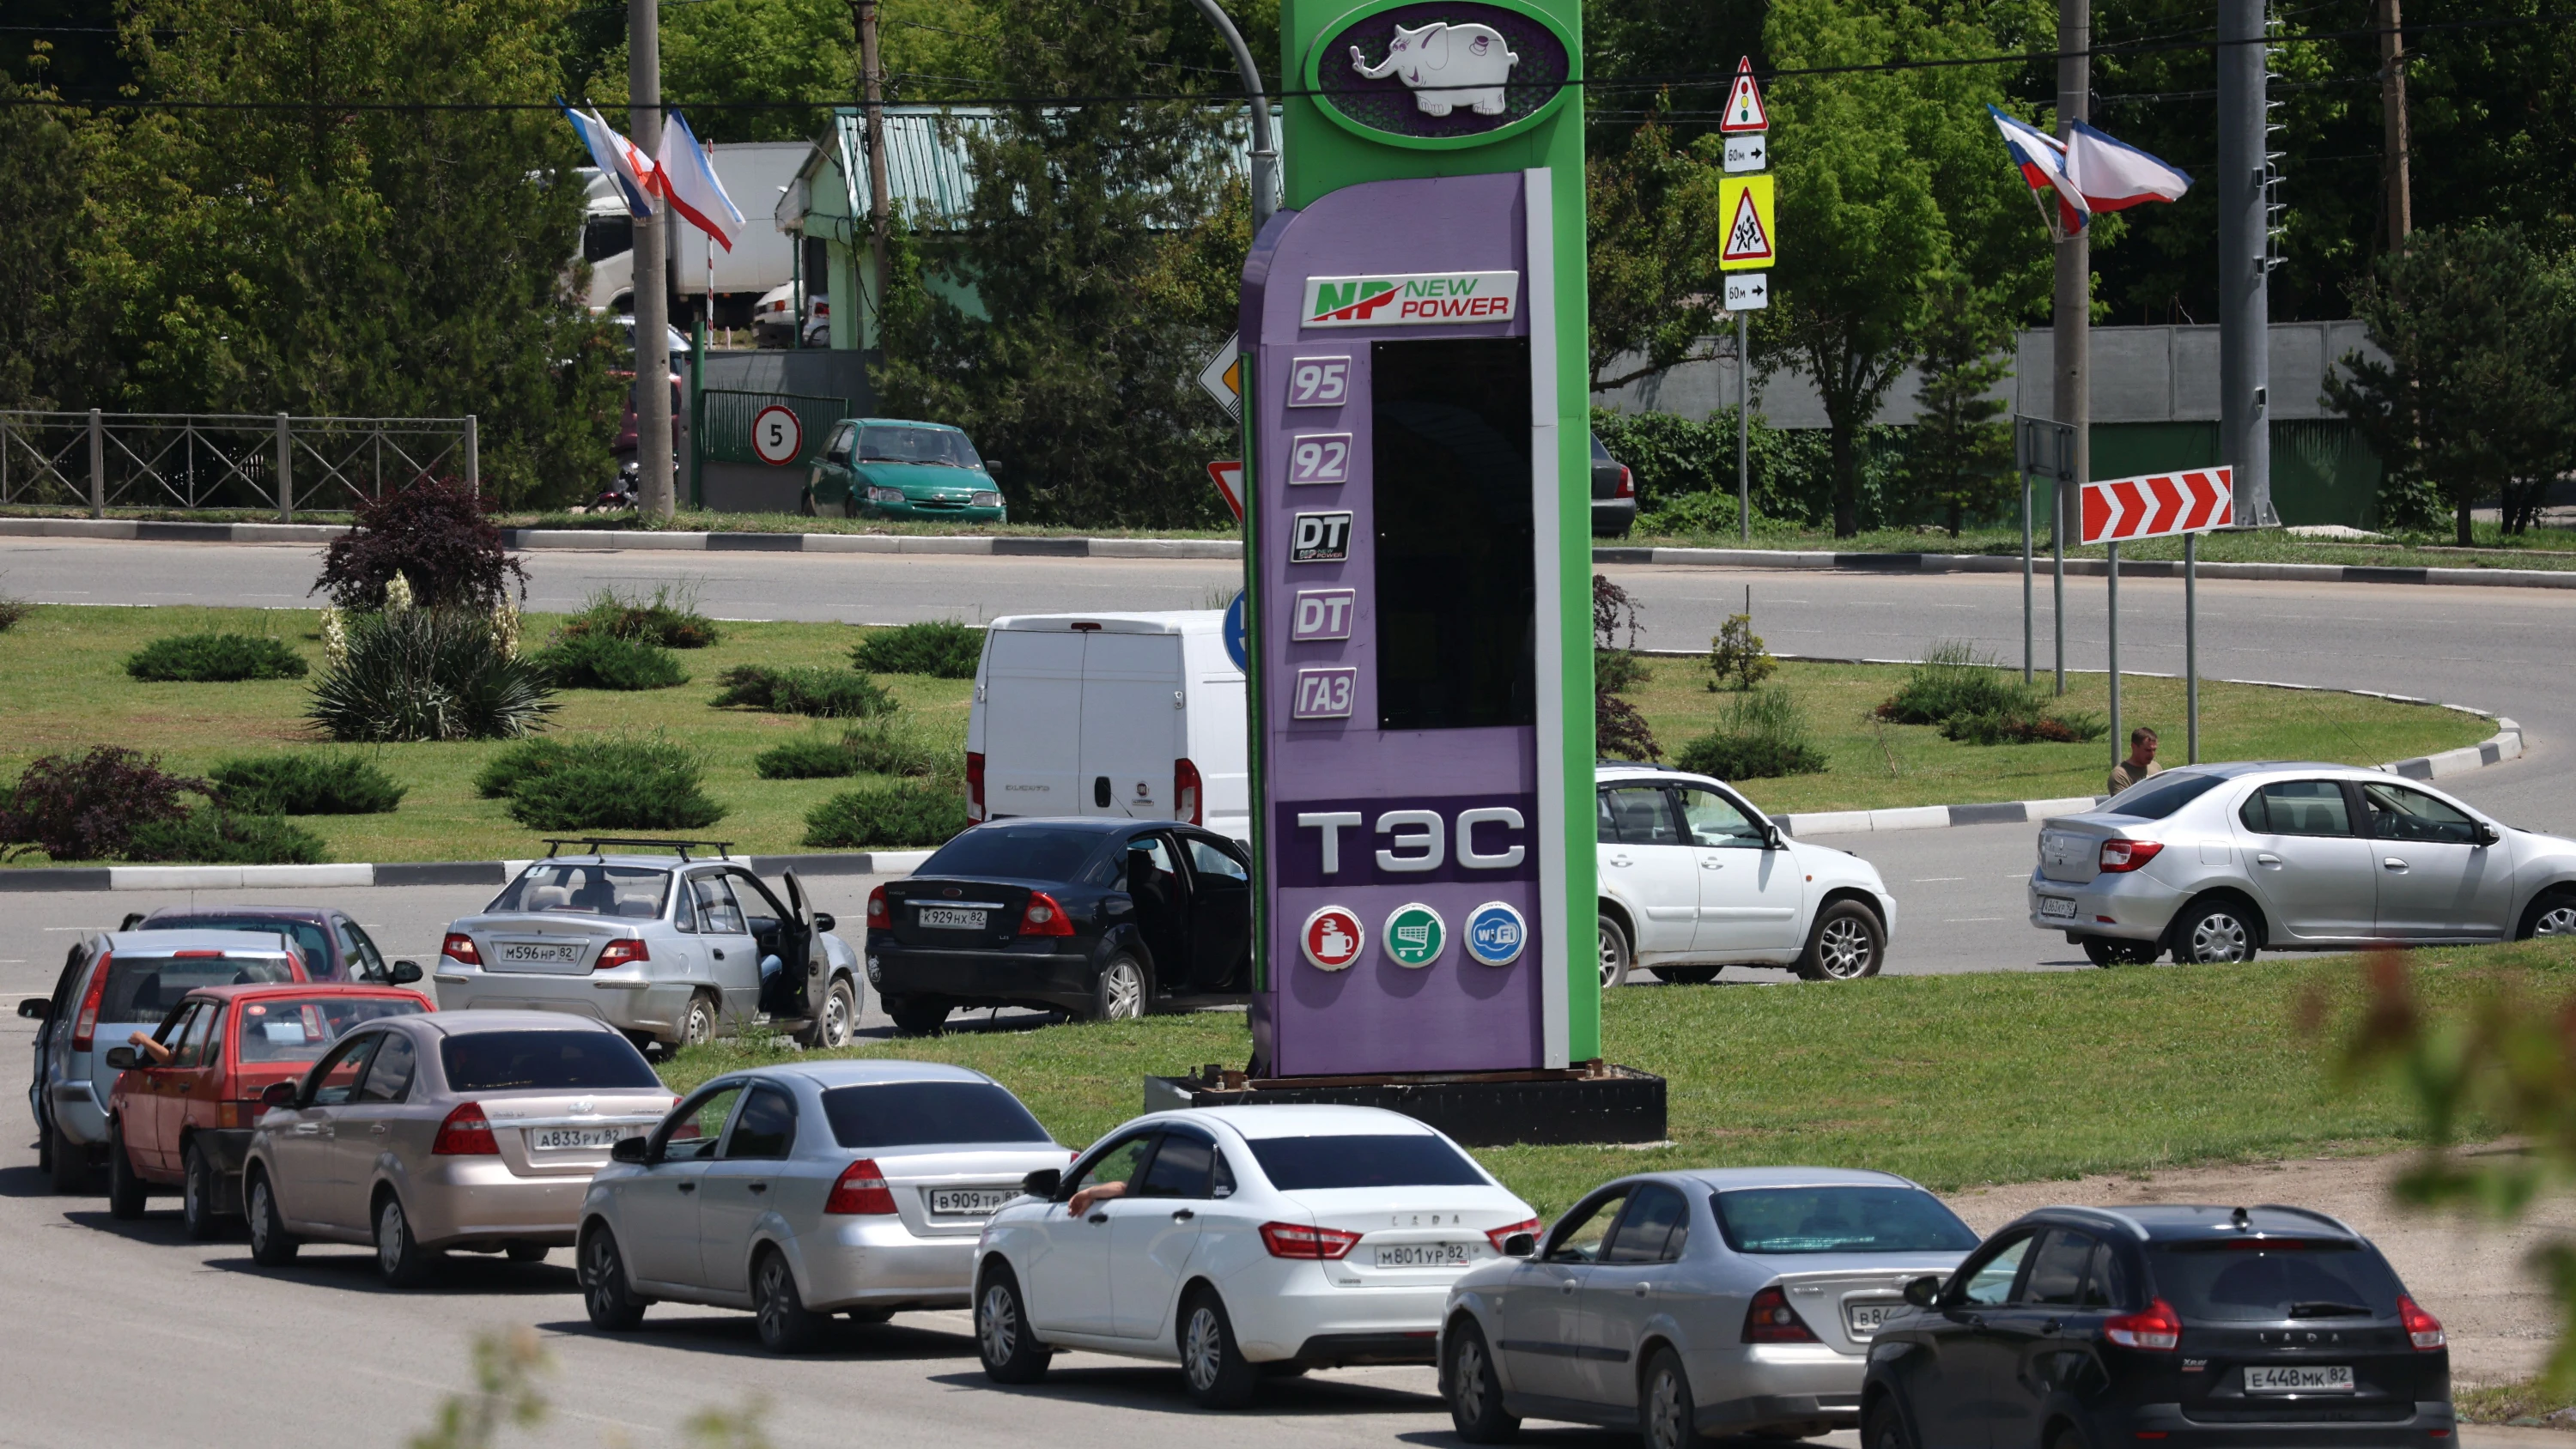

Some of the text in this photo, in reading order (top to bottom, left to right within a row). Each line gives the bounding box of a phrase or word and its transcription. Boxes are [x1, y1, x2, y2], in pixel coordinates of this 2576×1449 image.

[1404, 278, 1479, 298] NEW
[1312, 281, 1396, 322] NP
[1400, 296, 1510, 318] POWER
[1295, 365, 1345, 401] 95
[769, 424, 783, 447] 5
[1296, 442, 1346, 478] 92
[1295, 516, 1350, 550] DT
[1297, 597, 1352, 635] DT
[1299, 676, 1351, 712] ГАЗ
[1297, 807, 1525, 874] ТЭС
[970, 912, 983, 922] 82
[559, 947, 572, 958] 82
[605, 1129, 619, 1142] 82
[1448, 1245, 1463, 1258] 82
[2259, 1332, 2340, 1343] LADA
[2330, 1367, 2348, 1382] 82
